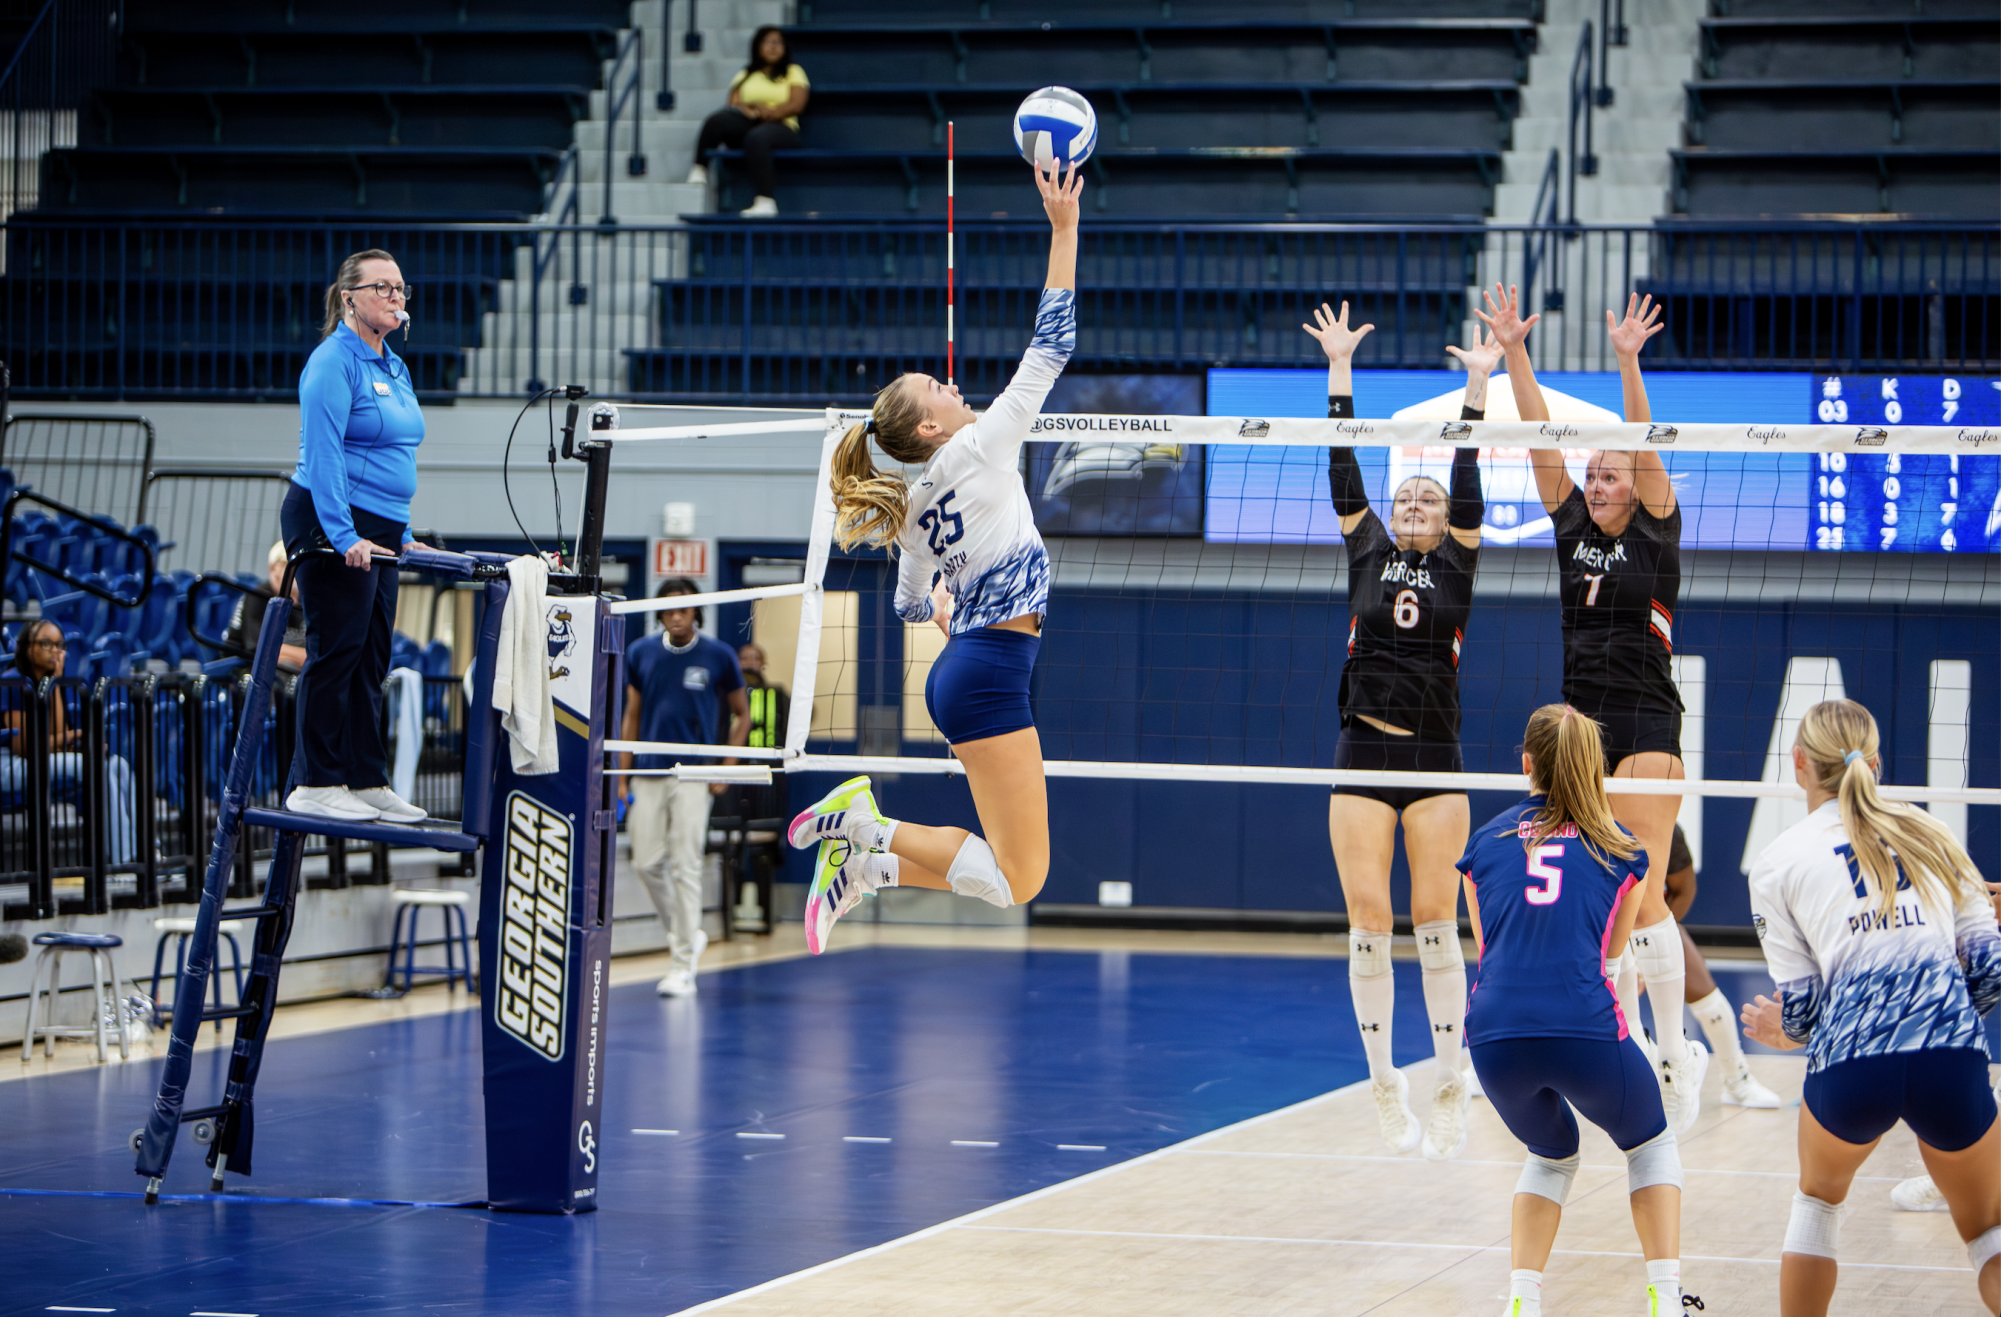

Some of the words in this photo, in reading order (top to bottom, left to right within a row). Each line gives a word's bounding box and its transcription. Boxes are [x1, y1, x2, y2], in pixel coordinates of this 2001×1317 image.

[1881, 378, 1899, 399] K
[1942, 378, 1961, 400] D
[1818, 400, 1848, 422] 03
[1884, 401, 1902, 423] 0
[1942, 401, 1959, 423] 7
[1030, 417, 1173, 433] @GSVOLLEYBALL
[1336, 421, 1375, 438] Eagles
[1539, 423, 1579, 441] Eagles
[1746, 426, 1786, 445] Eagles
[1957, 428, 1998, 447] Eagles
[1818, 475, 1847, 498] 16
[1883, 476, 1901, 500] 0
[1948, 477, 1959, 499] 1
[918, 489, 964, 557] 25
[1882, 502, 1899, 525] 3
[1940, 503, 1958, 525] 7
[1880, 528, 1898, 550] 7
[1940, 529, 1957, 551] 6
[660, 543, 704, 572] EXIT
[1393, 589, 1420, 629] 6
[1524, 843, 1566, 906] 5
[500, 796, 540, 1037] GEORGIA
[1848, 904, 1926, 936] POWELL
[530, 811, 570, 1057] SOUTHERN
[591, 960, 602, 1025] sports
[586, 1027, 599, 1107] imports
